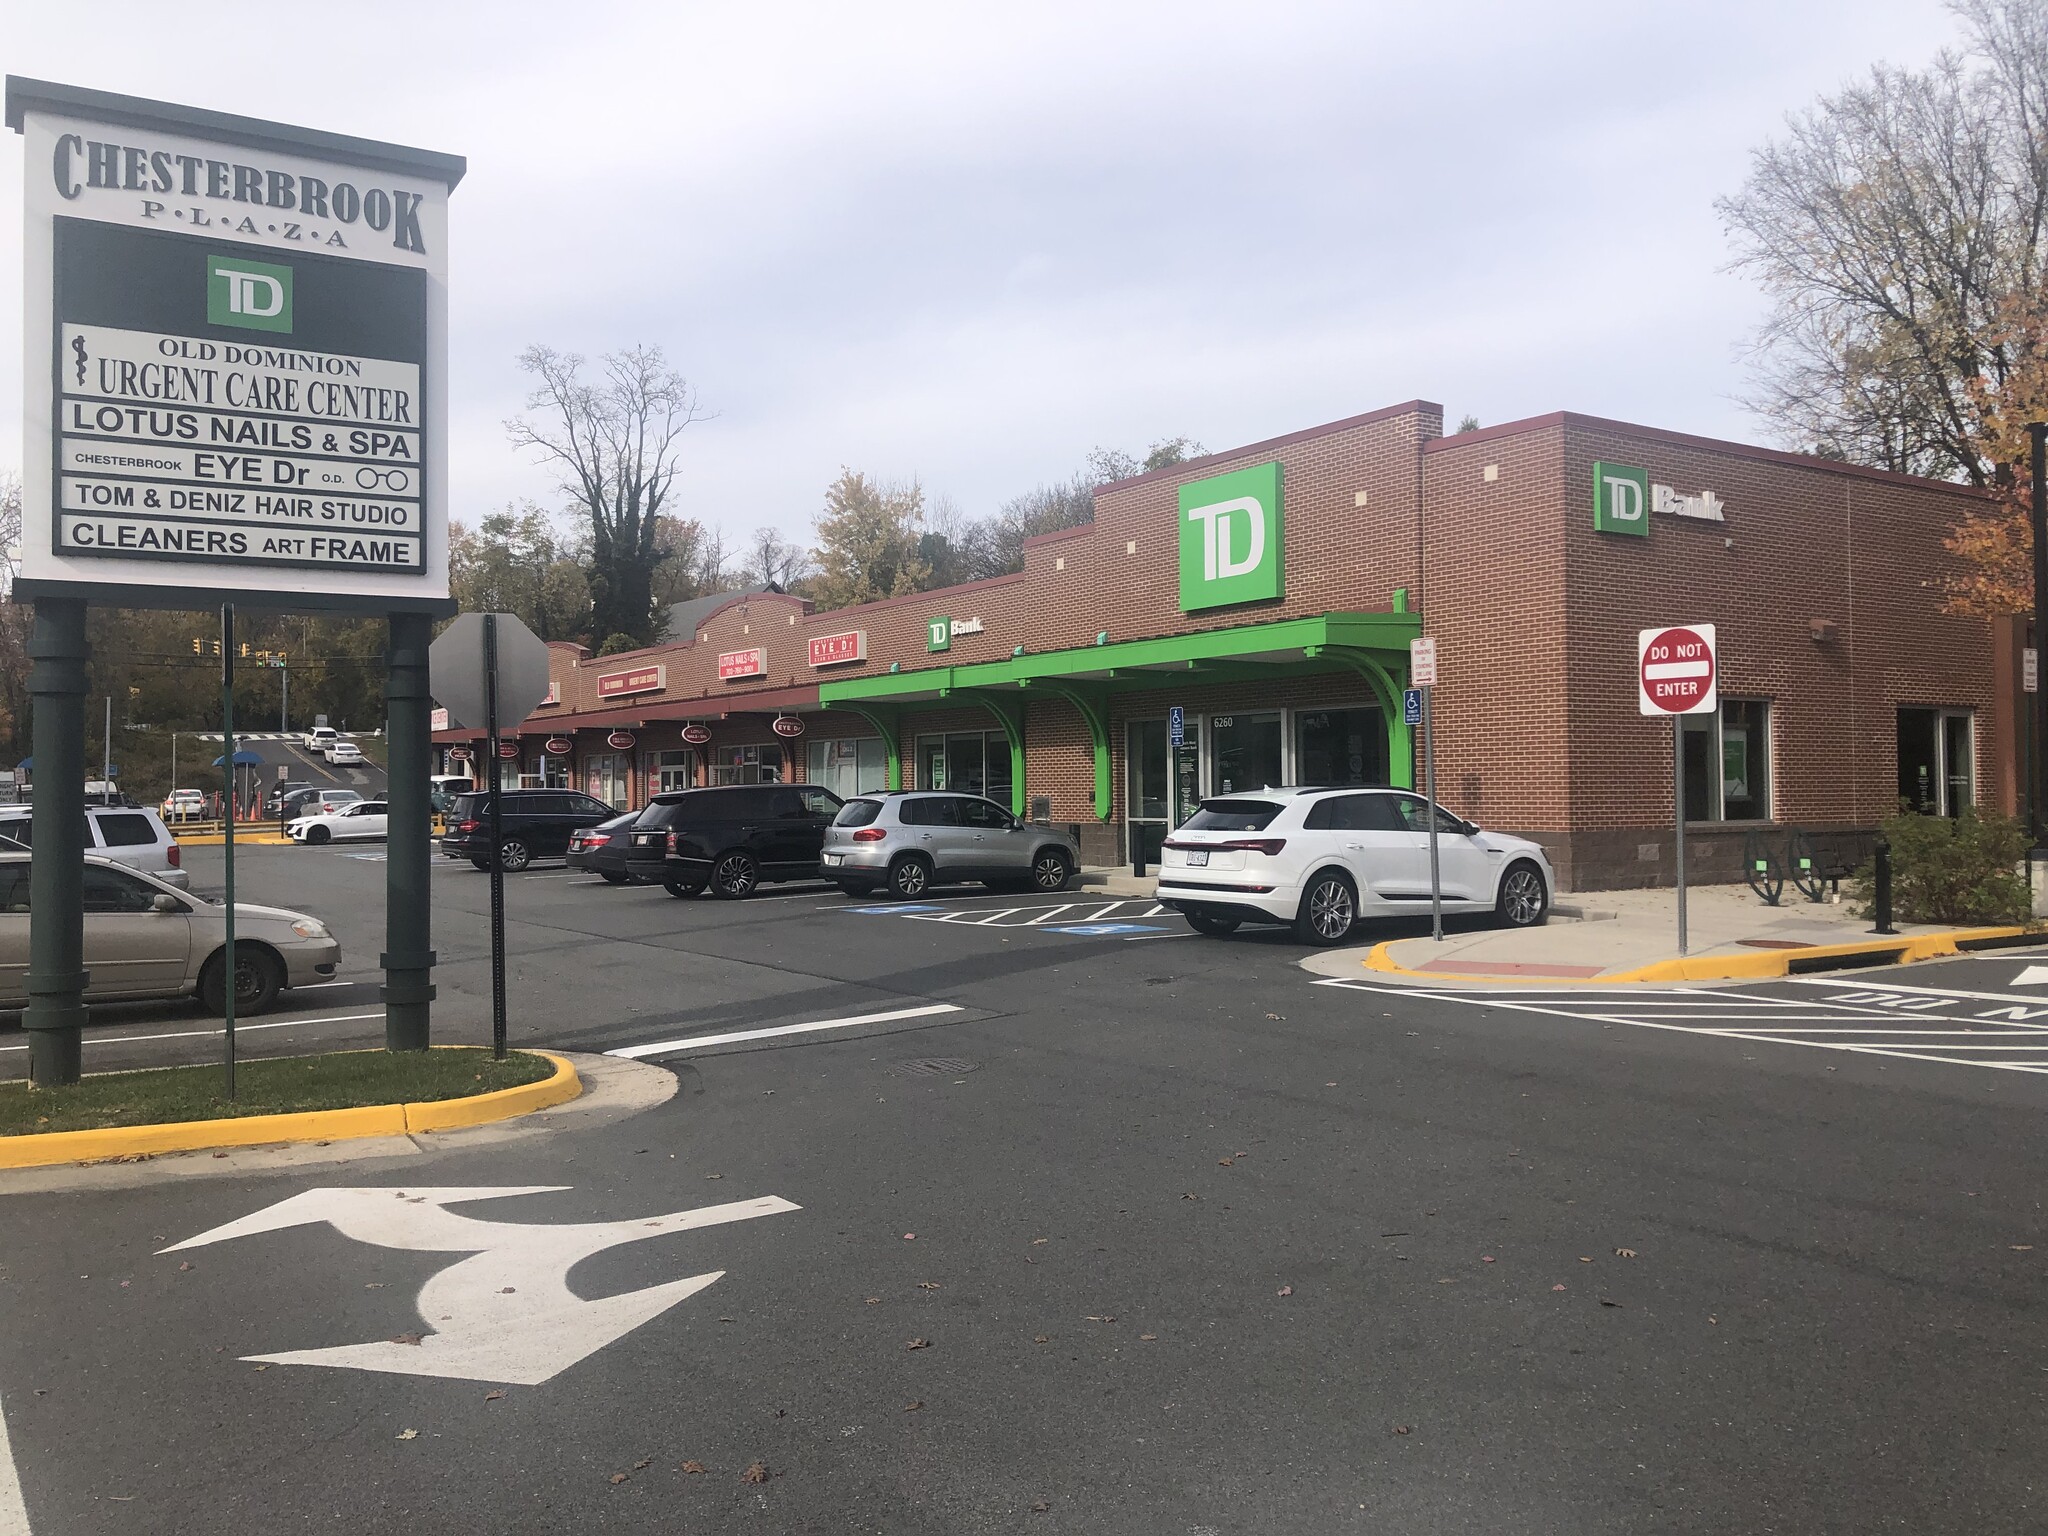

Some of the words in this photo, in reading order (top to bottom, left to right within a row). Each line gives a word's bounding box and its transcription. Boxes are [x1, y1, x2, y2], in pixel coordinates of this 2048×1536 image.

[53, 133, 426, 255] CHESTERBROOK
[215, 269, 285, 317] TD
[158, 338, 218, 361] OLD
[224, 343, 362, 378] DOMINION
[98, 357, 218, 404] URGENT
[225, 372, 300, 413] CARE
[307, 381, 411, 423] CENTER
[73, 404, 199, 439] LOTUS
[211, 417, 312, 449] NAILS
[322, 434, 339, 452] &
[349, 431, 411, 459] SPA
[75, 453, 182, 471] CHESTERBROOK
[194, 453, 262, 482] EYE
[273, 460, 310, 485] Dr
[321, 473, 345, 484] O.D.
[76, 483, 134, 507] TOM
[144, 488, 162, 508] &
[170, 490, 246, 514] DENIZ
[255, 495, 313, 519] HAIR
[321, 501, 408, 526] STUDIO
[1603, 476, 1643, 521] TD
[1652, 484, 1725, 521] Bank
[72, 523, 248, 554] CLEANERS
[262, 538, 305, 555] ART
[311, 537, 410, 564] FRAME
[1188, 496, 1265, 581] TD
[814, 642, 834, 655] EYE
[842, 640, 853, 651] Dr
[930, 622, 946, 644] TD
[951, 617, 984, 636] Bank
[720, 655, 735, 667] LOTUS
[735, 653, 748, 665] NAILS
[750, 652, 759, 663] SPA
[1415, 648, 1432, 656] PARKING
[1651, 646, 1669, 660] DO
[1676, 643, 1703, 658] NOT
[1656, 682, 1698, 697] ENTER
[1214, 717, 1233, 728] 6260
